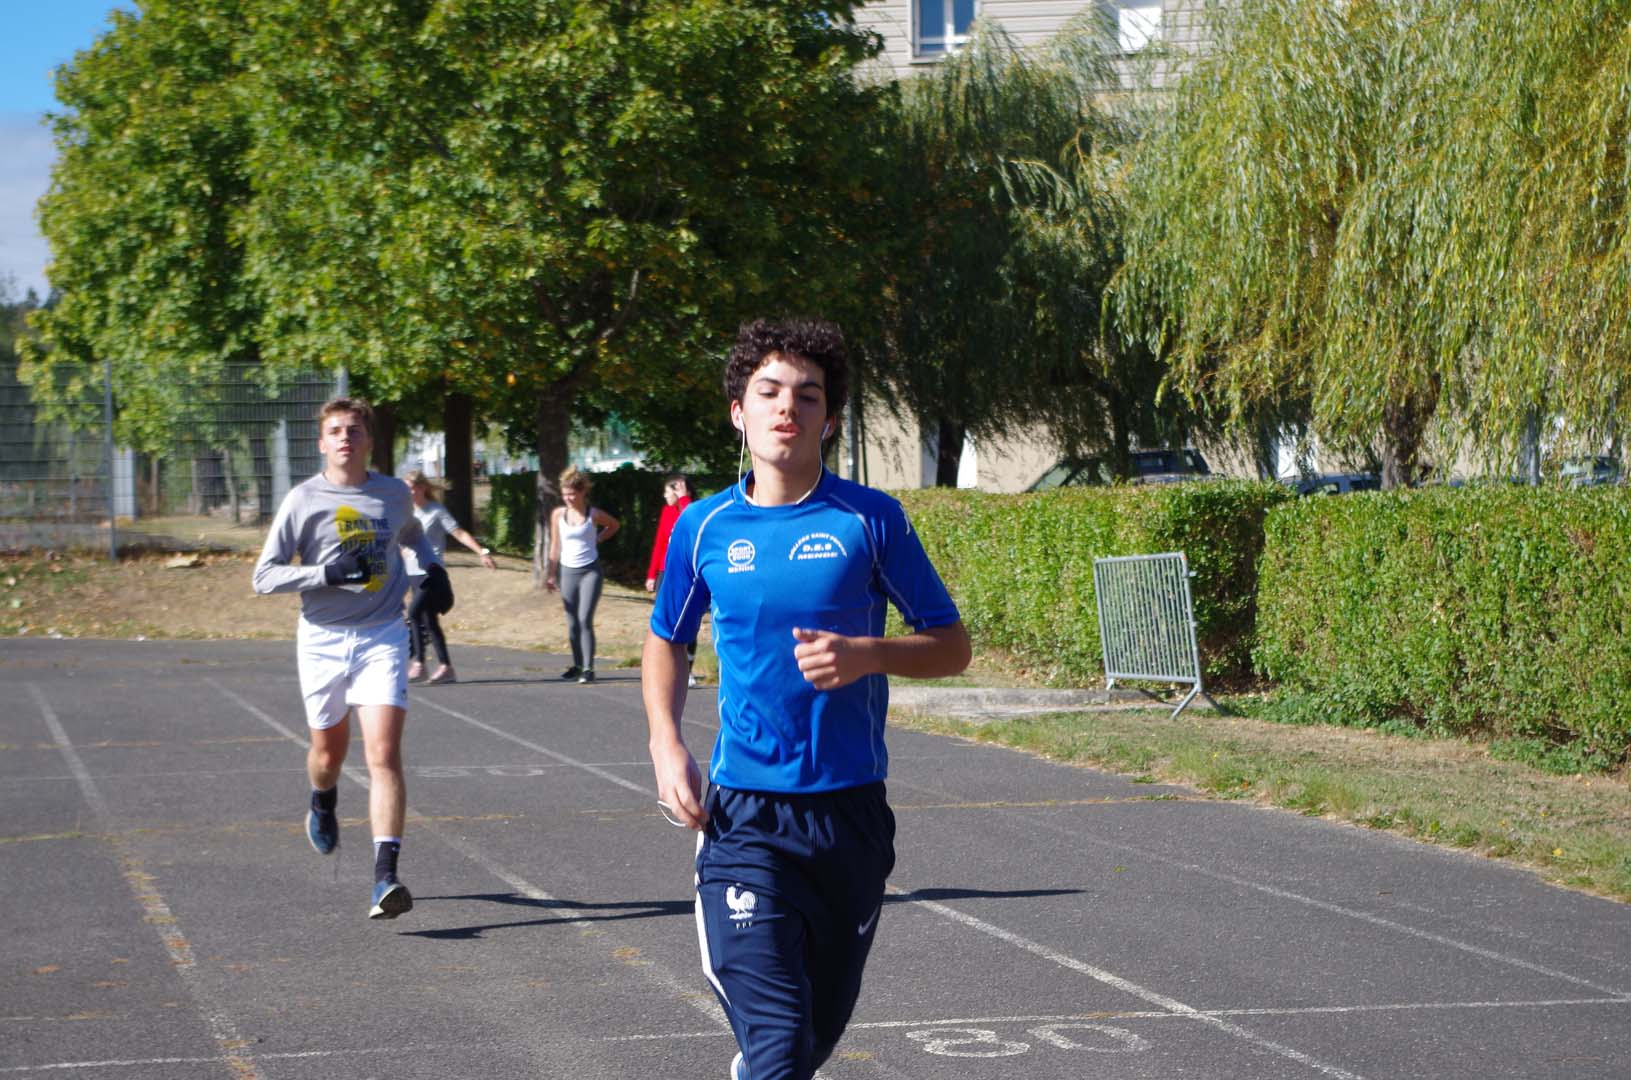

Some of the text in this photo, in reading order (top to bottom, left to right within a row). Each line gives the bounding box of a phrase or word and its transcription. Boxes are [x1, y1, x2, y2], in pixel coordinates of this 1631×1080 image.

[371, 519, 391, 530] THE
[797, 552, 838, 560] MENDE
[906, 1023, 1152, 1058] 80
